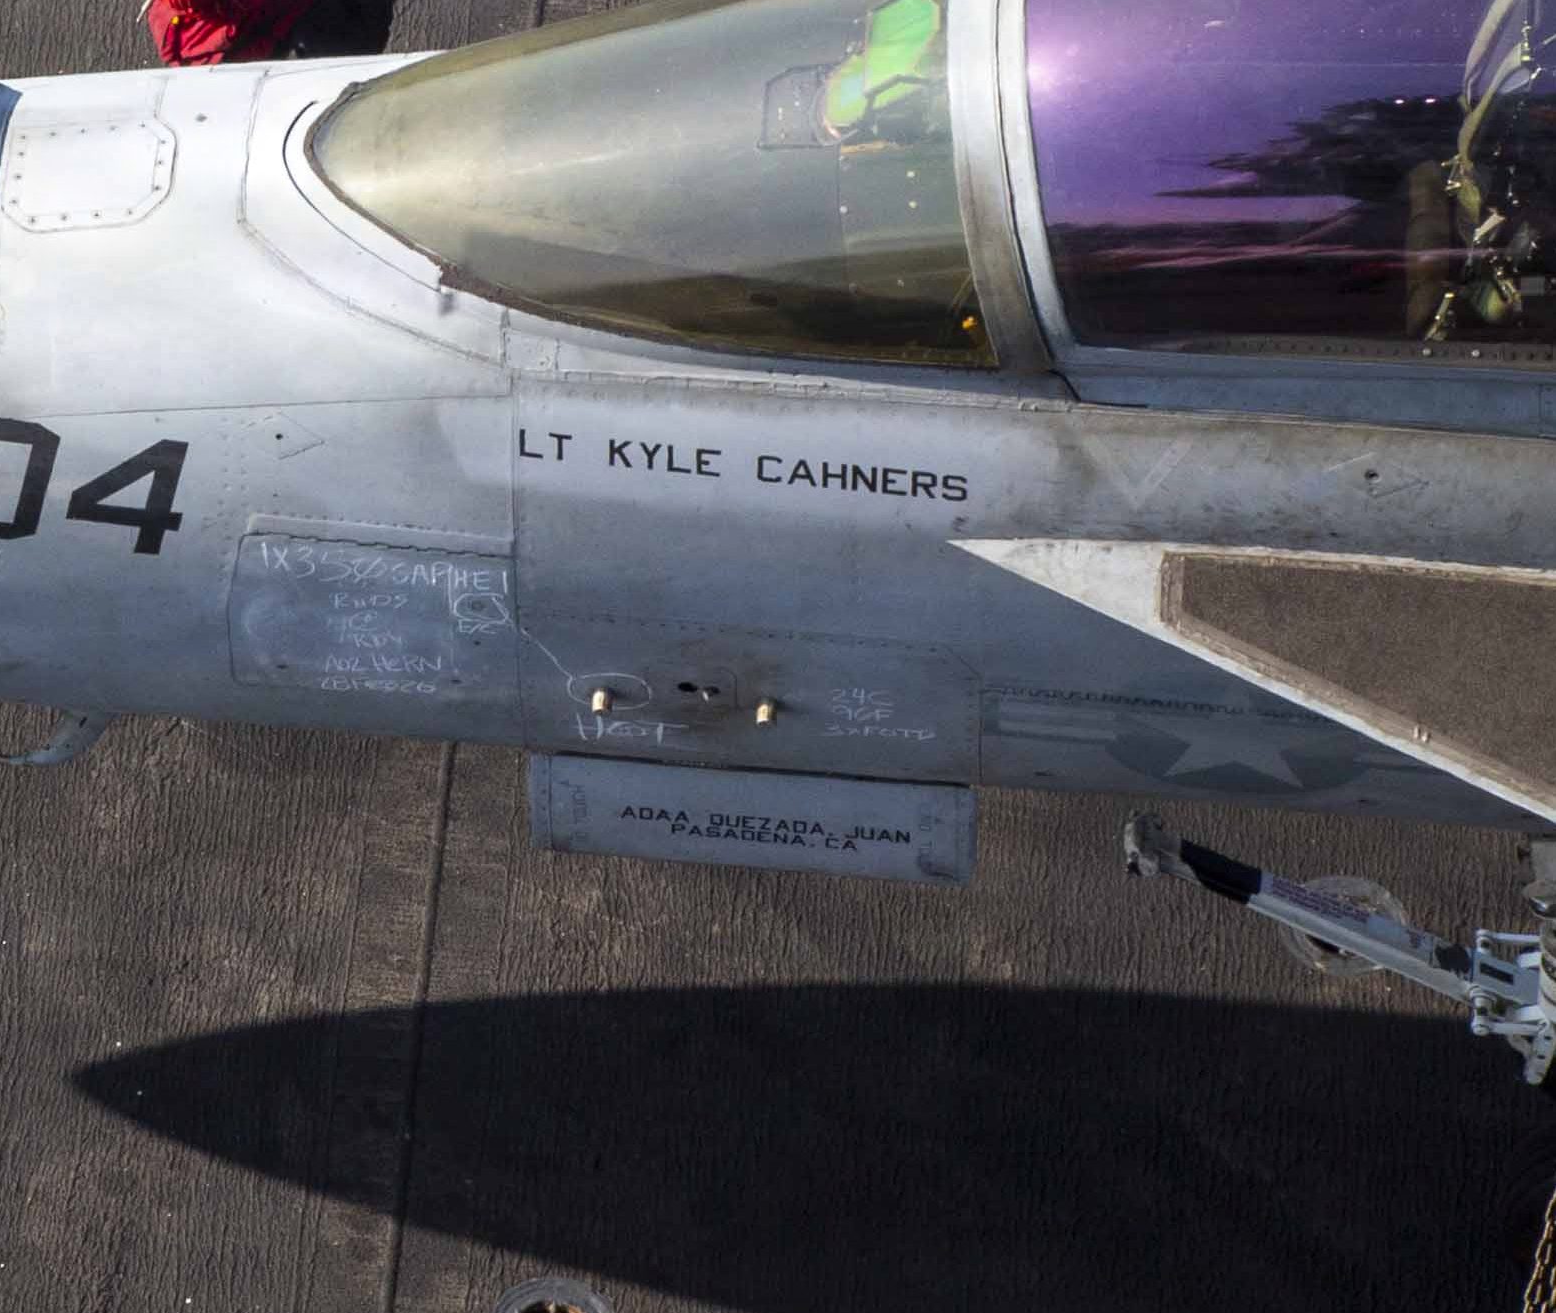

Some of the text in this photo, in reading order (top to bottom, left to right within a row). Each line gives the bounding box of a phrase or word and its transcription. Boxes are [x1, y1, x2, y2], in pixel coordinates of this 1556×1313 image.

[518, 428, 969, 502] LT KYLE CAHNERS
[824, 837, 858, 852] CA
[844, 825, 911, 845] JUAN
